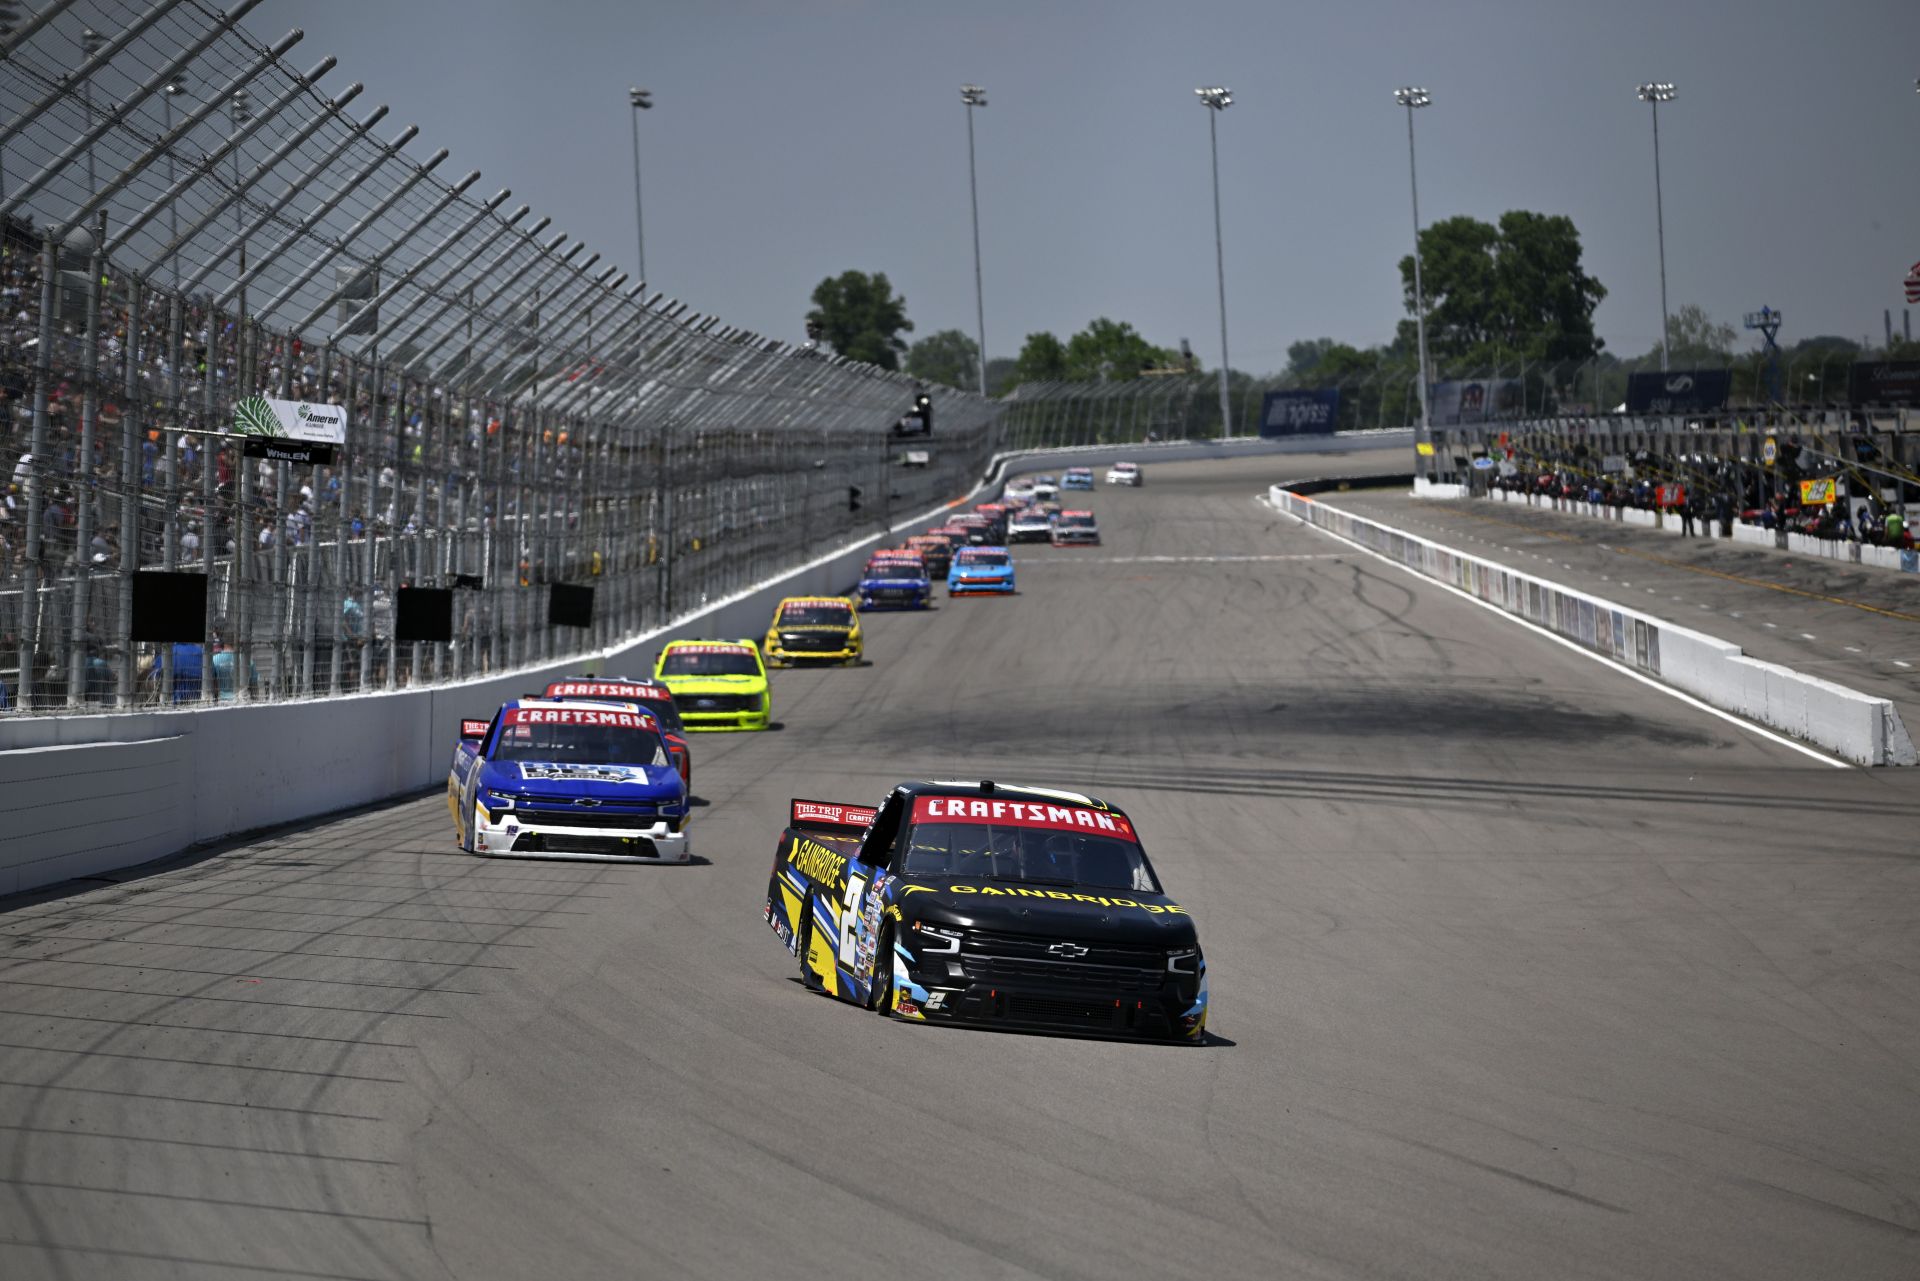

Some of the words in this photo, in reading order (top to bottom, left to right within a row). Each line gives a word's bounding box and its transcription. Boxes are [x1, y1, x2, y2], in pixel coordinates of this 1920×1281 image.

[306, 413, 339, 425] Ameren
[266, 448, 310, 461] WHELEN
[554, 684, 660, 698] CRAFTSMAN
[516, 711, 648, 728] CRAFTSMAN
[796, 803, 816, 814] THE
[817, 805, 843, 819] TRIP
[849, 814, 876, 823] CRAFTS
[928, 799, 1116, 831] CRAFTSMAN
[796, 840, 847, 890] GAINBRIDGE
[950, 885, 1189, 915] GAINBRIDGE
[839, 873, 867, 969] 2
[925, 991, 947, 1010] 2
